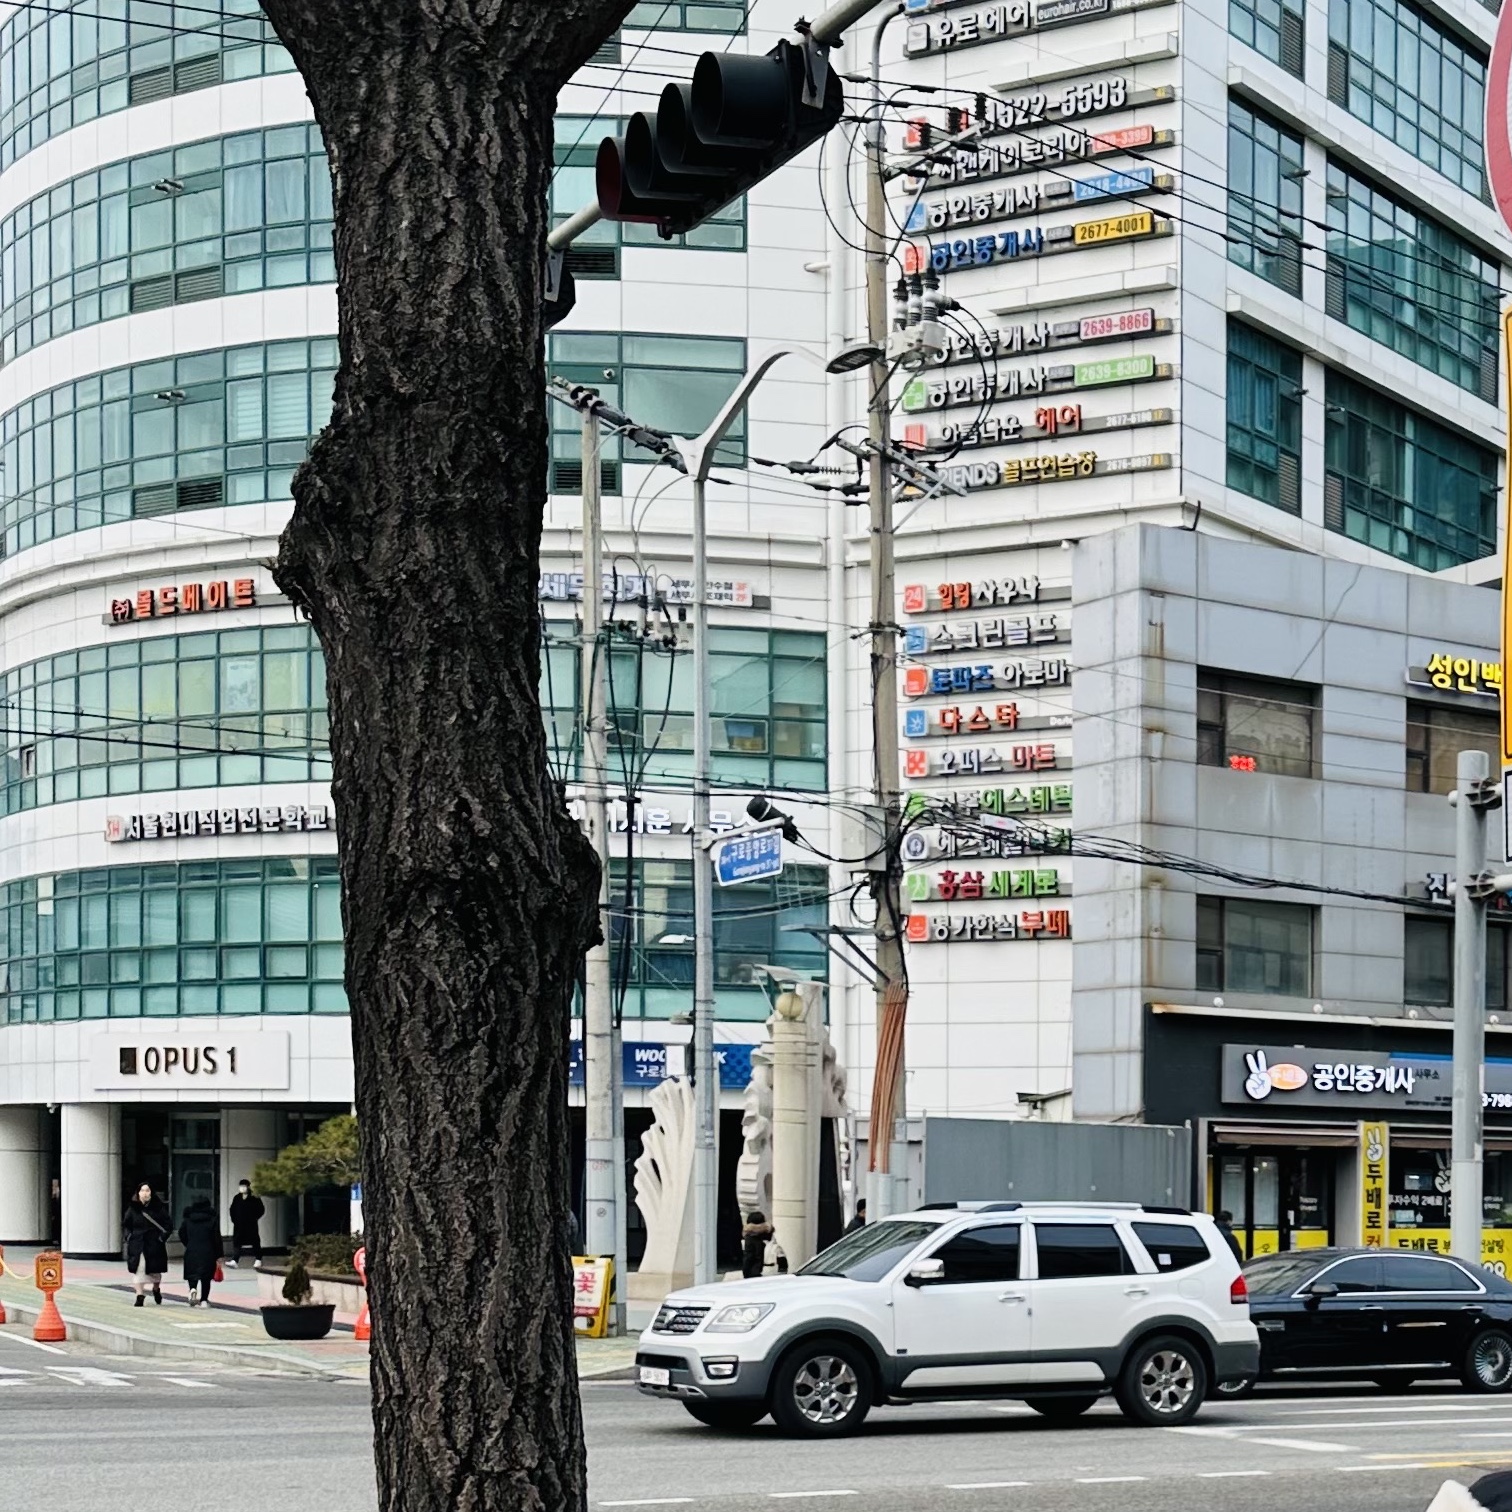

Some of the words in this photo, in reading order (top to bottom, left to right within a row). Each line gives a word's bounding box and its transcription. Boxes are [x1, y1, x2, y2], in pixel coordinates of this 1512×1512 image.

[928, 182, 1040, 227] 공인중개사
[932, 226, 1043, 270] 공인중개사
[1080, 216, 1146, 240] 2677-4001
[1082, 312, 1150, 338] 2639-8866
[928, 366, 1047, 407] 공인중개사
[1033, 404, 1082, 434] 헤어
[1004, 451, 1097, 483] 골프연습장
[977, 575, 1039, 605] 사우나
[932, 614, 1057, 650] 스크린골프
[1001, 659, 1069, 687] 아로마
[939, 702, 1019, 733] 다스타
[936, 746, 1002, 774] 오피스
[1012, 744, 1056, 769] 마트
[126, 804, 328, 839] 서울현대직업전문학교
[938, 870, 984, 899] 홍삼
[988, 869, 1058, 897] 세계로
[144, 1046, 218, 1074] OPUS
[227, 1046, 238, 1073] 1
[1312, 1063, 1415, 1095] 공인중개사
[1366, 1163, 1383, 1229] 두배로
[574, 1271, 597, 1294] 꽃
